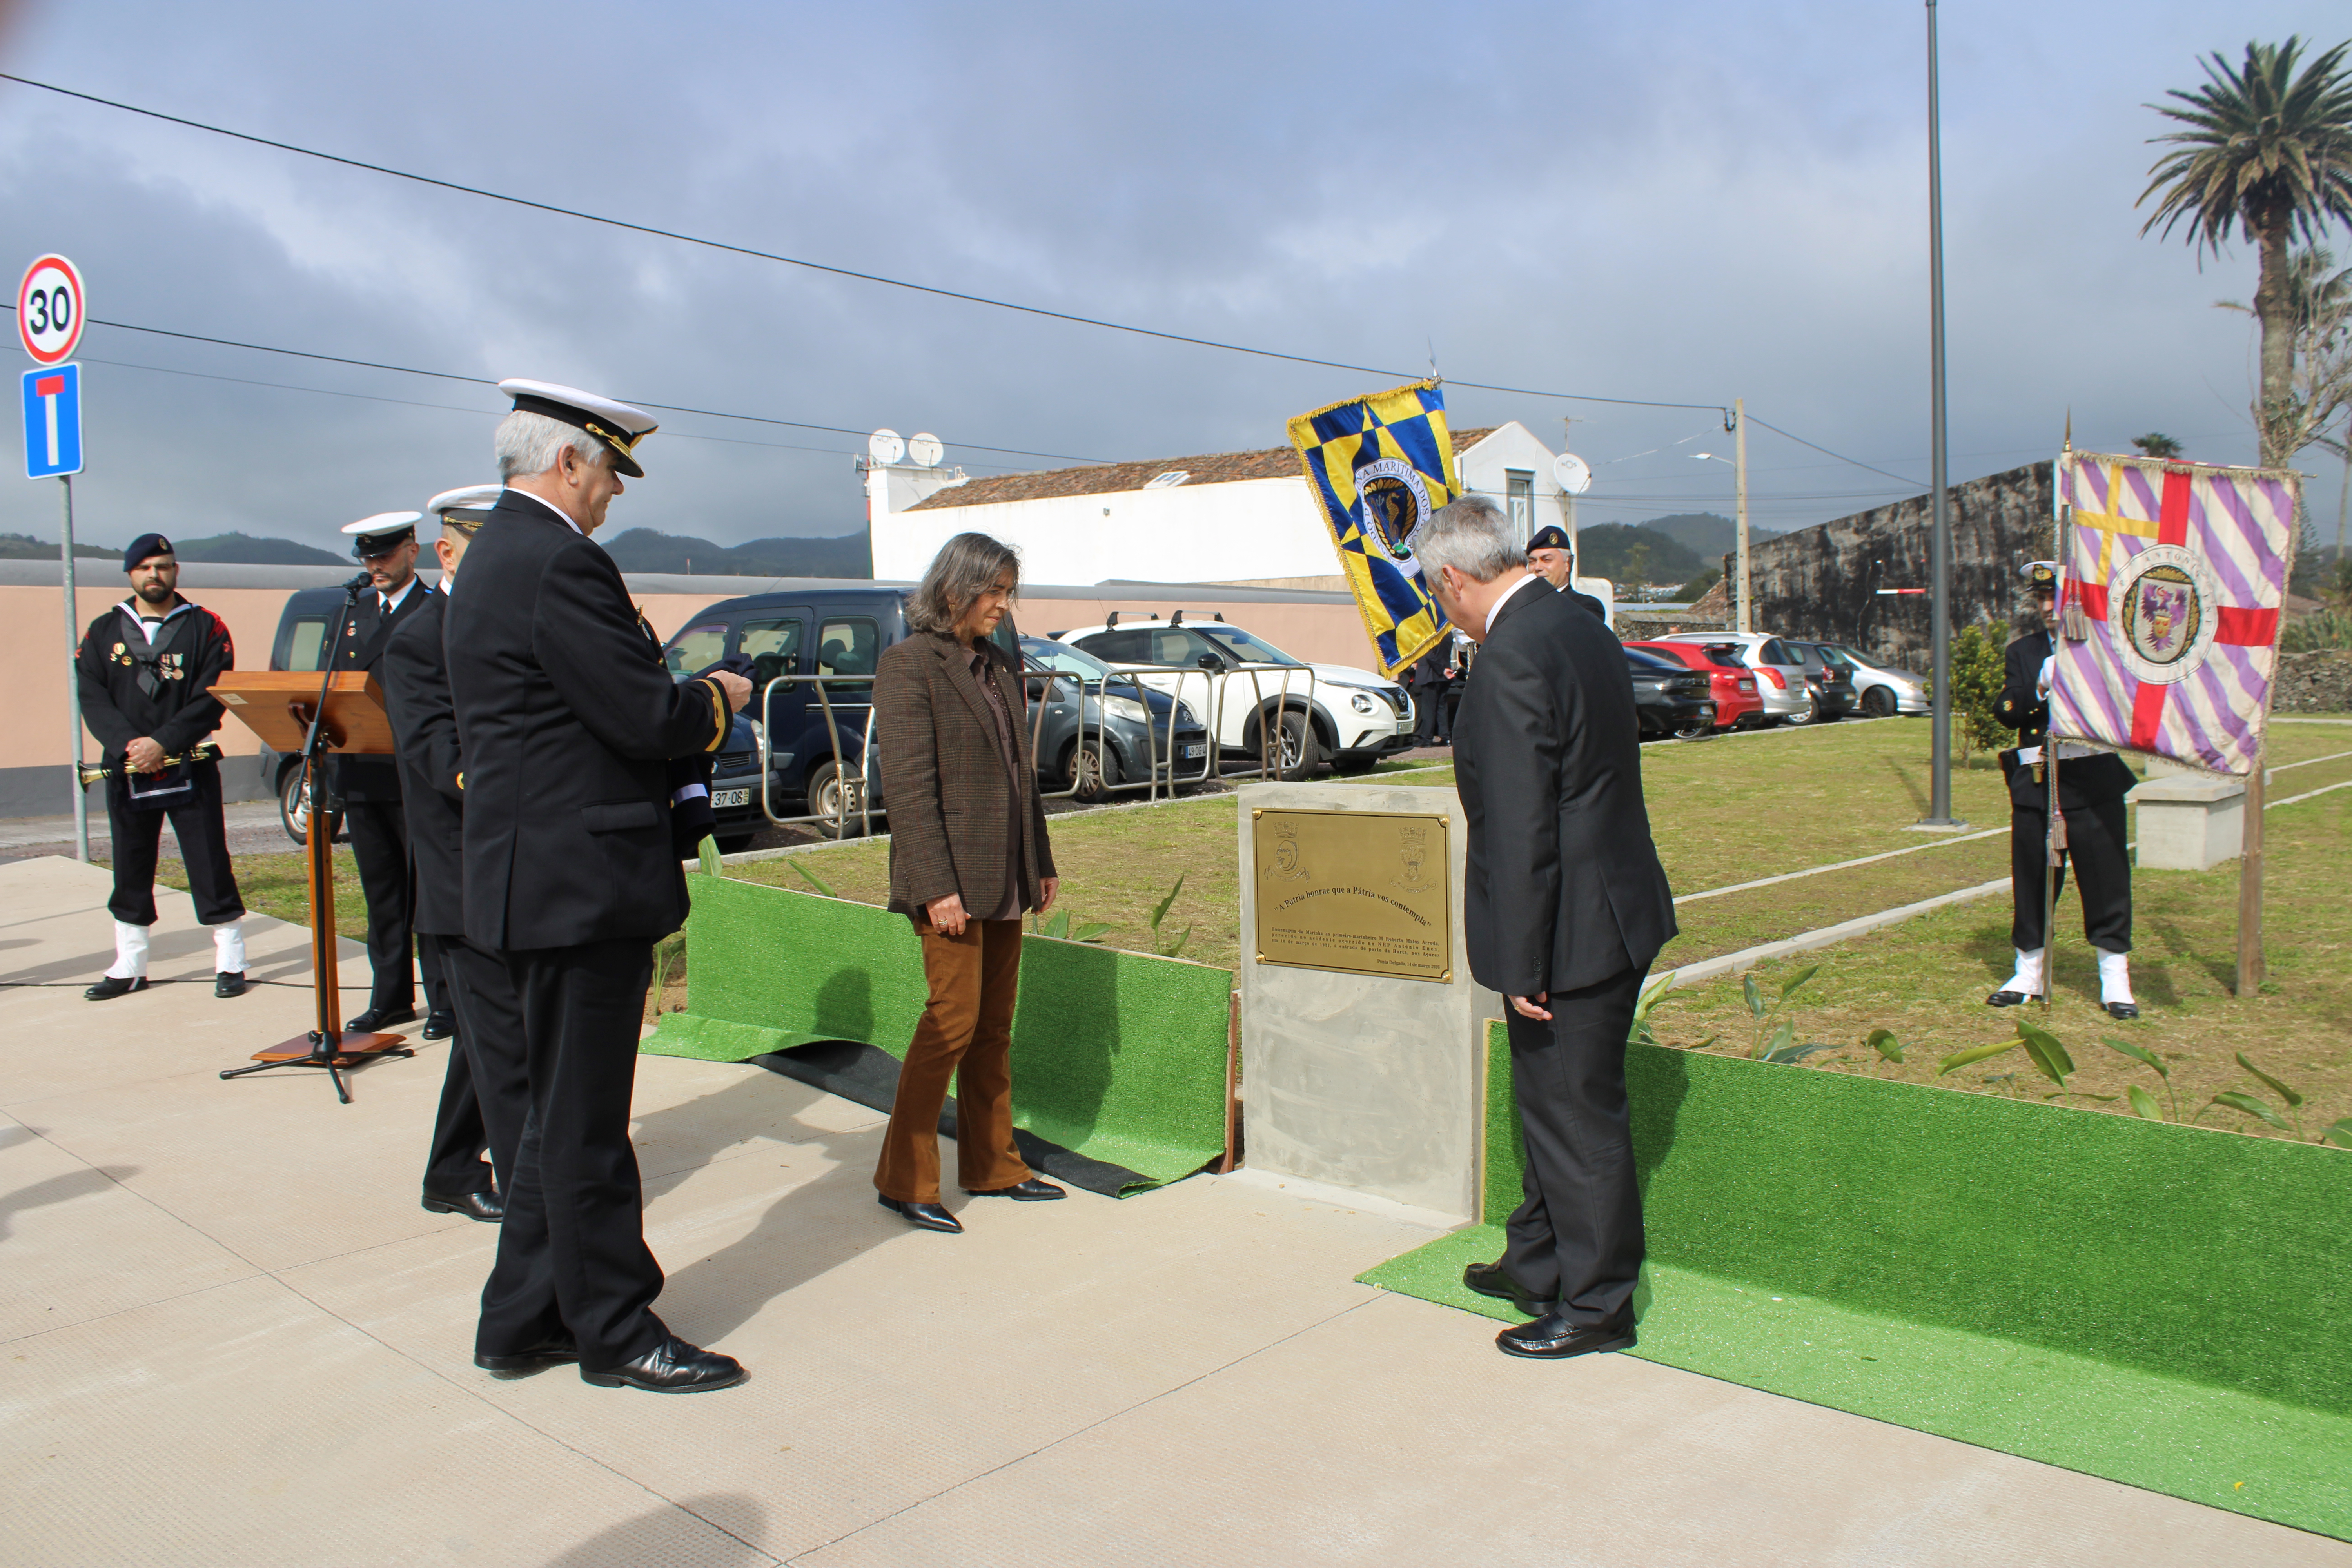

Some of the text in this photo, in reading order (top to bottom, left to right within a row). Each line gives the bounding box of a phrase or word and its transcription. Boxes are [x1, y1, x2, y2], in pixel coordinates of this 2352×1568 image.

[30, 286, 70, 335] 30
[1373, 460, 1420, 489] MARÍTIMA
[1419, 489, 1429, 515] DOS
[1274, 904, 1285, 912] "A
[1283, 893, 1305, 907] Pátria
[1306, 887, 1330, 898] honrae
[1353, 886, 1375, 898] Pátria
[1377, 894, 1389, 903] vos
[1390, 899, 1432, 927] contempla"
